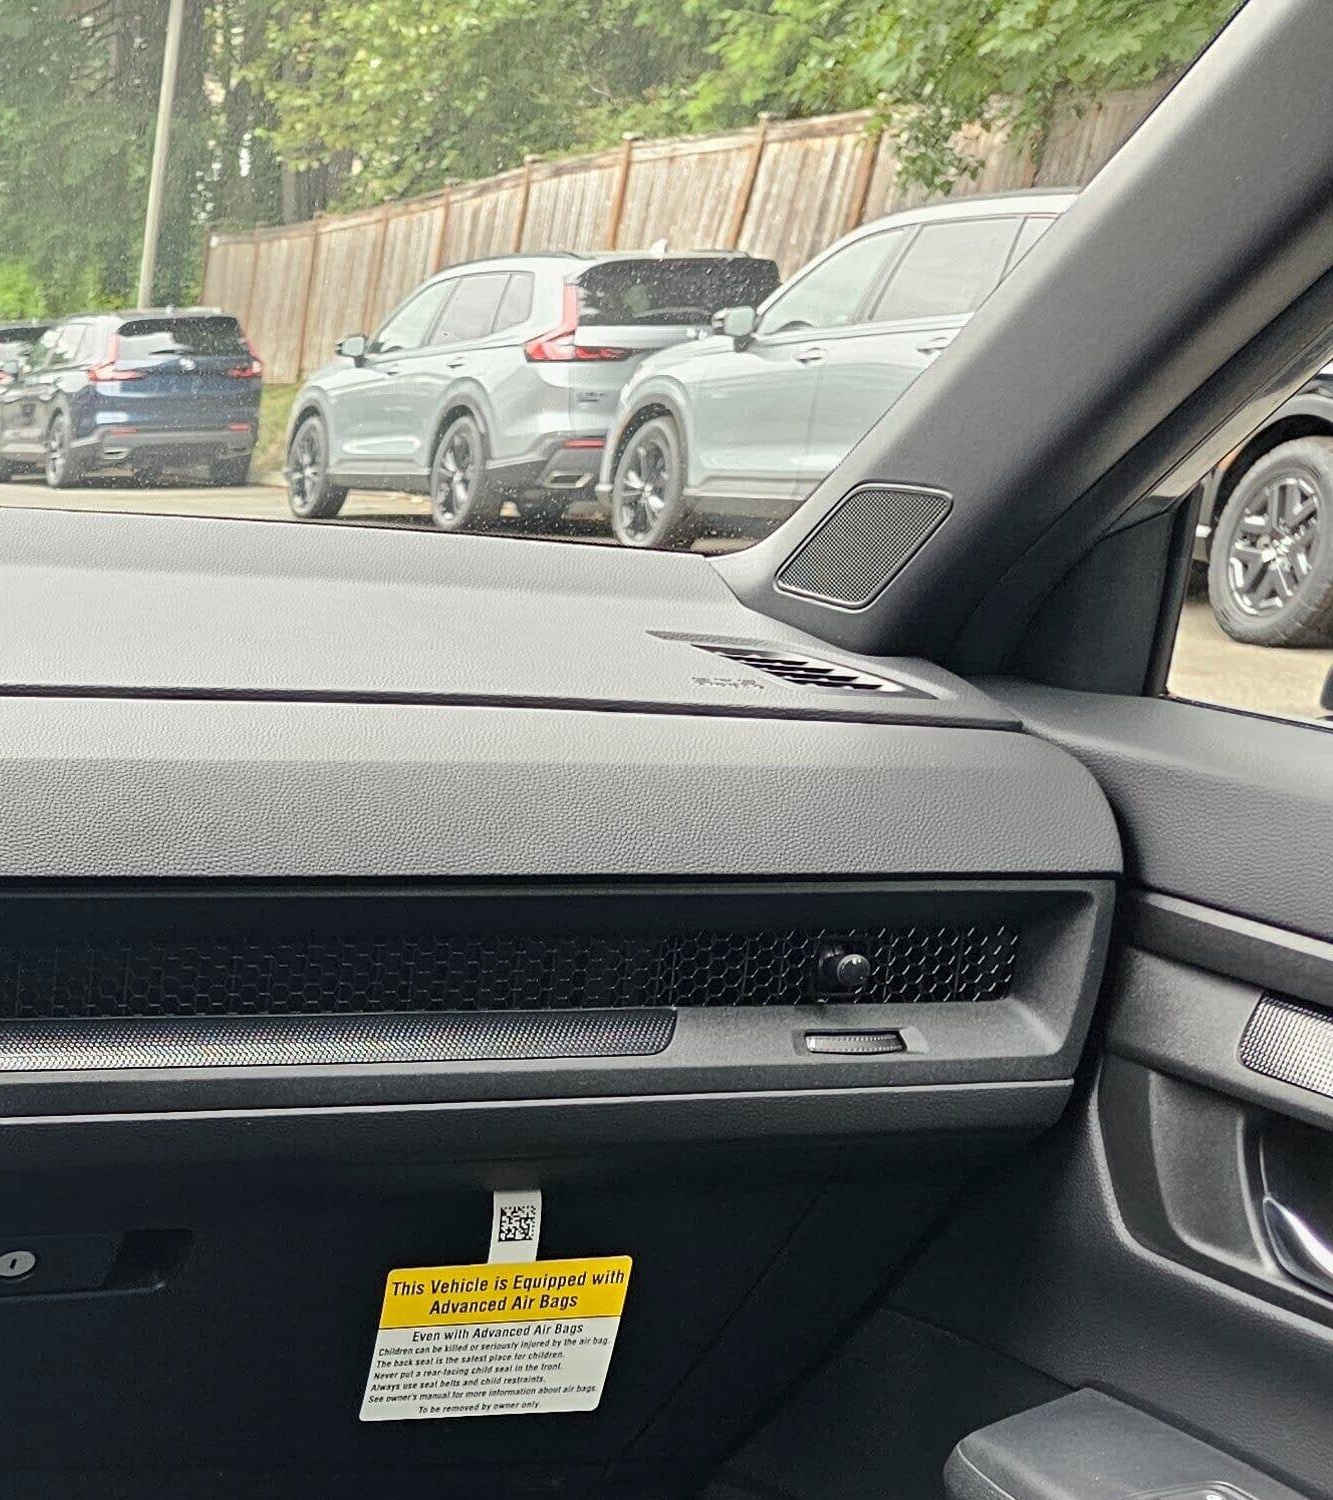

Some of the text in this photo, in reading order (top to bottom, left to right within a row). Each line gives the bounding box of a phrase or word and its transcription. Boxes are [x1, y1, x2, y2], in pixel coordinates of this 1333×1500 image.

[392, 1269, 625, 1296] This Vehicle is Equipped with
[429, 1294, 579, 1315] Advanced Air Bags
[412, 1323, 584, 1342] Even with Advanced Air Bags
[378, 1347, 413, 1357] Children
[415, 1347, 430, 1355] can
[432, 1345, 443, 1353] be
[444, 1344, 468, 1353] killed
[481, 1341, 519, 1350] seriously
[520, 1339, 550, 1349] injured
[552, 1339, 562, 1348] by
[564, 1338, 577, 1346] the
[579, 1337, 591, 1345] air
[376, 1360, 391, 1369] The
[393, 1358, 413, 1367] back
[415, 1357, 434, 1366] seat
[435, 1357, 443, 1365] is
[445, 1356, 459, 1365] the
[461, 1355, 488, 1364] safest
[488, 1353, 512, 1362] place
[528, 1351, 565, 1360] children.
[373, 1372, 398, 1380] Never
[400, 1370, 414, 1380] put
[471, 1366, 493, 1375] child
[494, 1364, 513, 1373] seat
[525, 1363, 539, 1371] the
[370, 1383, 400, 1392] Always
[419, 1381, 438, 1389] seat
[439, 1379, 460, 1388] belts
[462, 1378, 479, 1386] and
[480, 1377, 501, 1385] child
[503, 1375, 546, 1385] restraints.
[368, 1395, 384, 1404] See
[385, 1394, 418, 1403] owner's
[419, 1391, 451, 1400] manual
[452, 1391, 463, 1399] for
[465, 1390, 486, 1398] more
[488, 1387, 536, 1397] information
[537, 1386, 562, 1395] about
[562, 1385, 575, 1393] air
[418, 1406, 428, 1414] To
[430, 1405, 441, 1413] be
[442, 1403, 480, 1412] removed
[481, 1403, 492, 1411] by
[521, 1400, 542, 1409] only.
